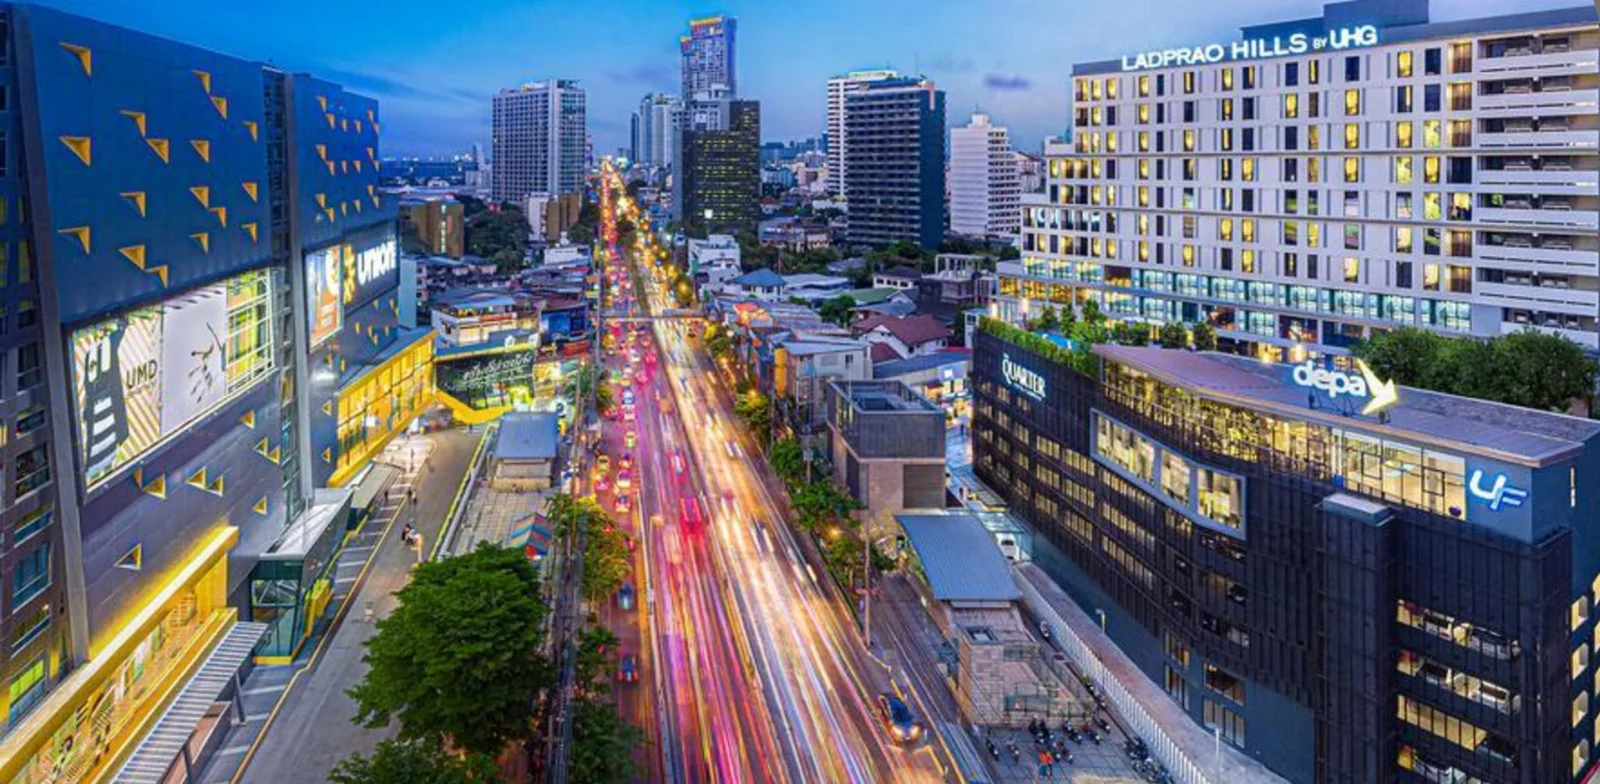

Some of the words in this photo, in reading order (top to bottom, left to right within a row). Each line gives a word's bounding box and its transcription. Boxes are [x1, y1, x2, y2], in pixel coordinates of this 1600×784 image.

[1121, 43, 1225, 71] LADPRAO
[1231, 32, 1308, 59] HILLS
[1313, 37, 1327, 49] BY
[1330, 25, 1377, 49] UHG
[126, 359, 158, 389] UMD
[1293, 361, 1367, 397] depa
